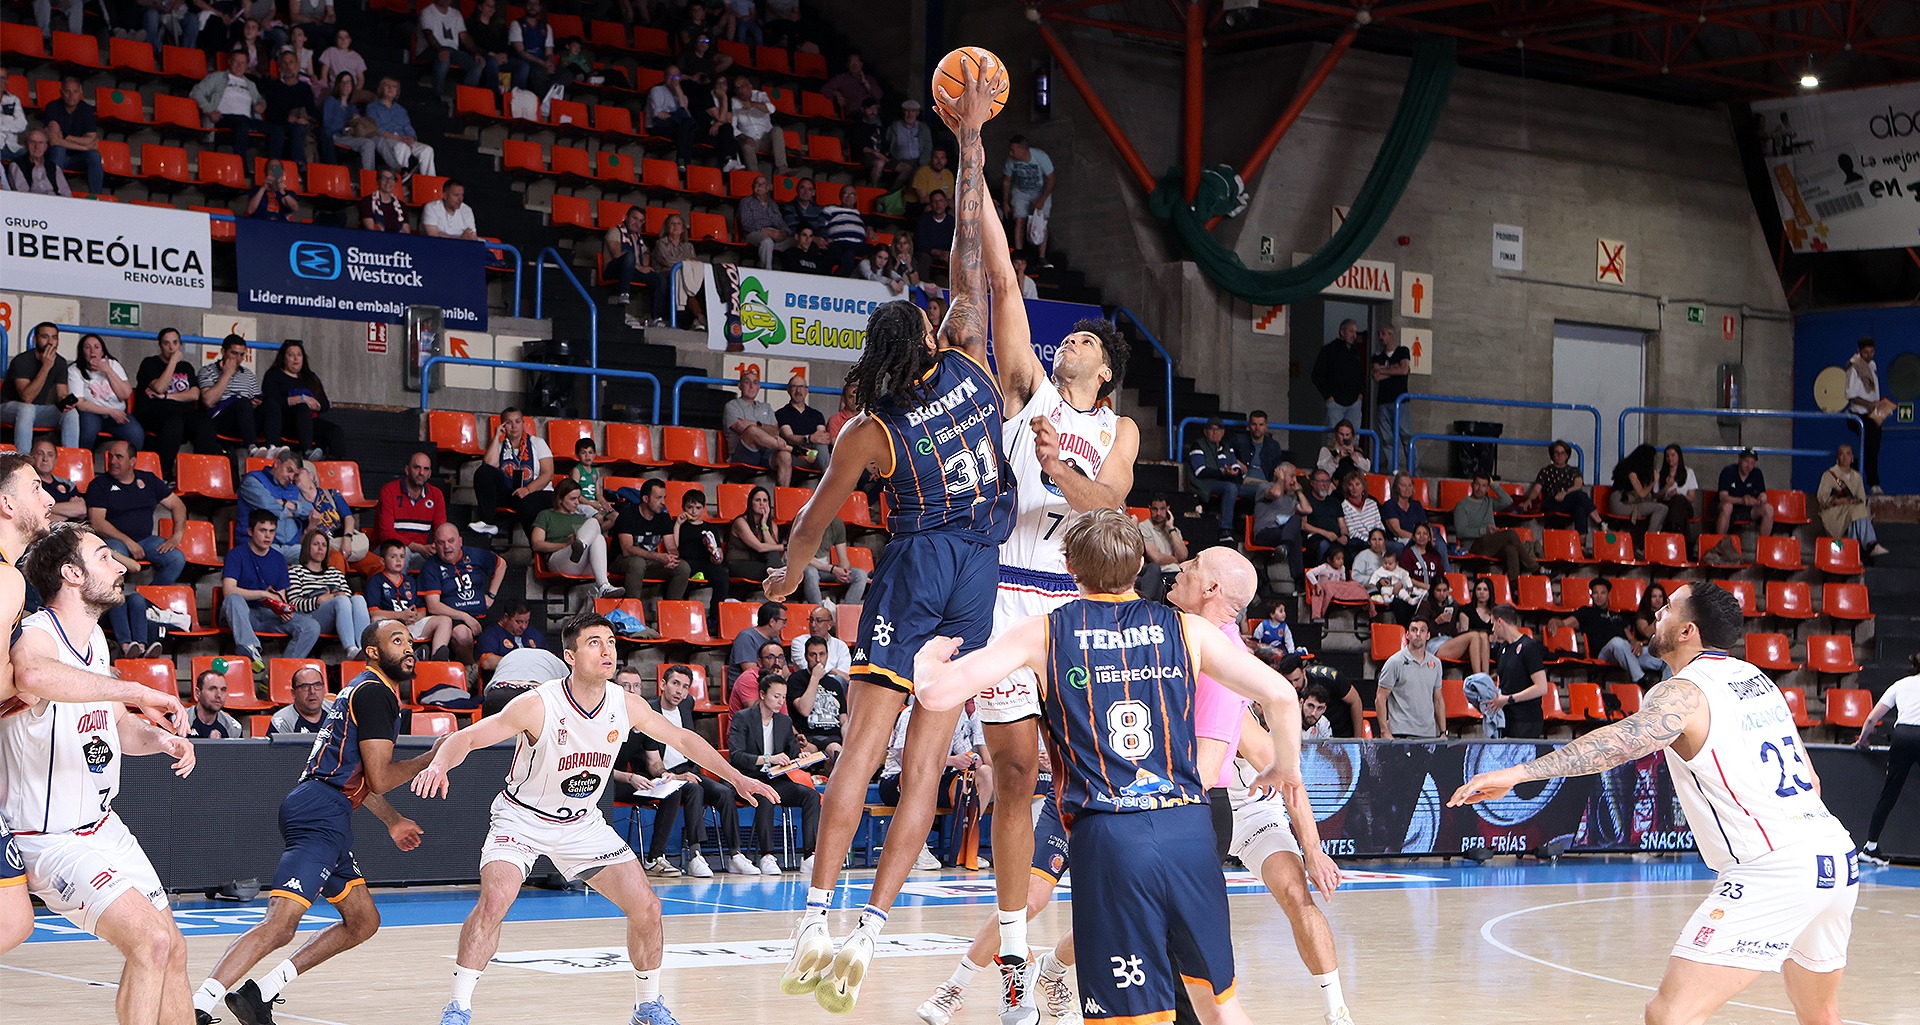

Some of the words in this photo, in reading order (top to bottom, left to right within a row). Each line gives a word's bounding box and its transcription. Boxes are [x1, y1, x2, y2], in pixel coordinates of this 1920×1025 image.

[1860, 154, 1877, 168] La
[1869, 176, 1903, 198] en
[5, 217, 48, 230] GRUPO
[7, 231, 204, 275] IBEREÓLICA
[347, 246, 413, 269] Smurfit
[124, 271, 205, 288] RENOVABLES
[347, 264, 423, 288] Westrock
[1335, 265, 1391, 293] GRIMA
[285, 294, 337, 310] mundial
[338, 300, 354, 311] en
[356, 299, 409, 318] embalaj
[791, 316, 867, 350] Eduar
[904, 376, 979, 428] BROWN
[936, 403, 996, 445] IBEREÓLICA
[942, 435, 999, 496] 31
[1057, 432, 1102, 477] RADOIRO
[1043, 512, 1064, 541] 7
[454, 573, 473, 592] 13
[1074, 624, 1165, 650] TERINS
[1096, 665, 1183, 684] IBEREÓLICA
[1106, 700, 1155, 761] 8
[558, 751, 612, 772] OBRADOIRO
[1760, 736, 1813, 798] 23
[567, 783, 594, 794] Galicia
[568, 777, 597, 788] Estrella
[1321, 839, 1356, 855] NTES
[1491, 831, 1527, 851] FRÍAS
[1639, 831, 1694, 850] SNACKS
[1719, 881, 1744, 900] 23
